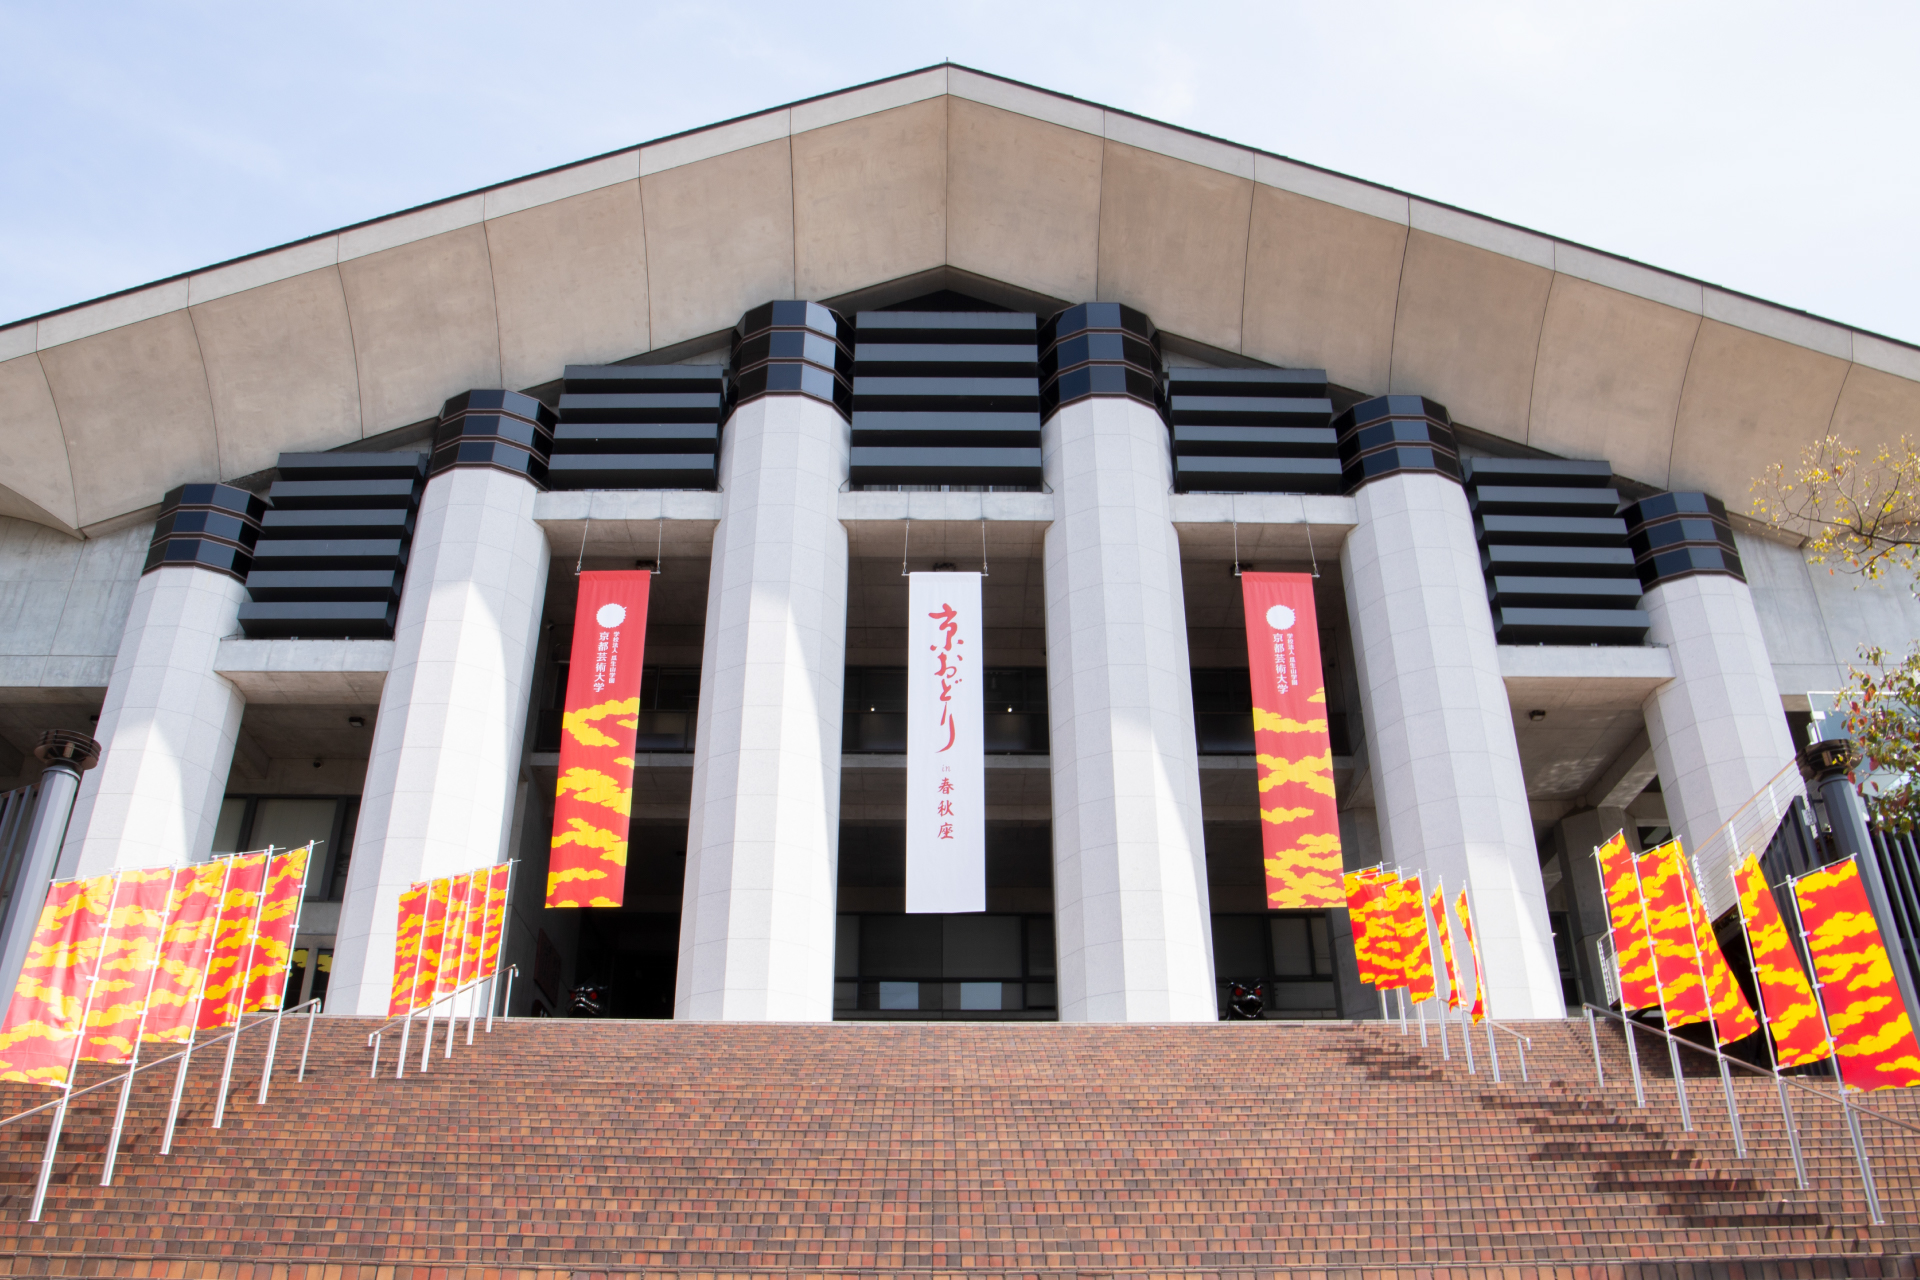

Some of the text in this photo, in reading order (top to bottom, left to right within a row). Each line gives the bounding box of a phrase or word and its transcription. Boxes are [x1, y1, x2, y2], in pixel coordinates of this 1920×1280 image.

[593, 632, 609, 692] 京都芸術大学
[928, 603, 963, 753] 京おどり
[1273, 633, 1288, 694] 京都芸術大学
[937, 777, 954, 840] 春秋座
